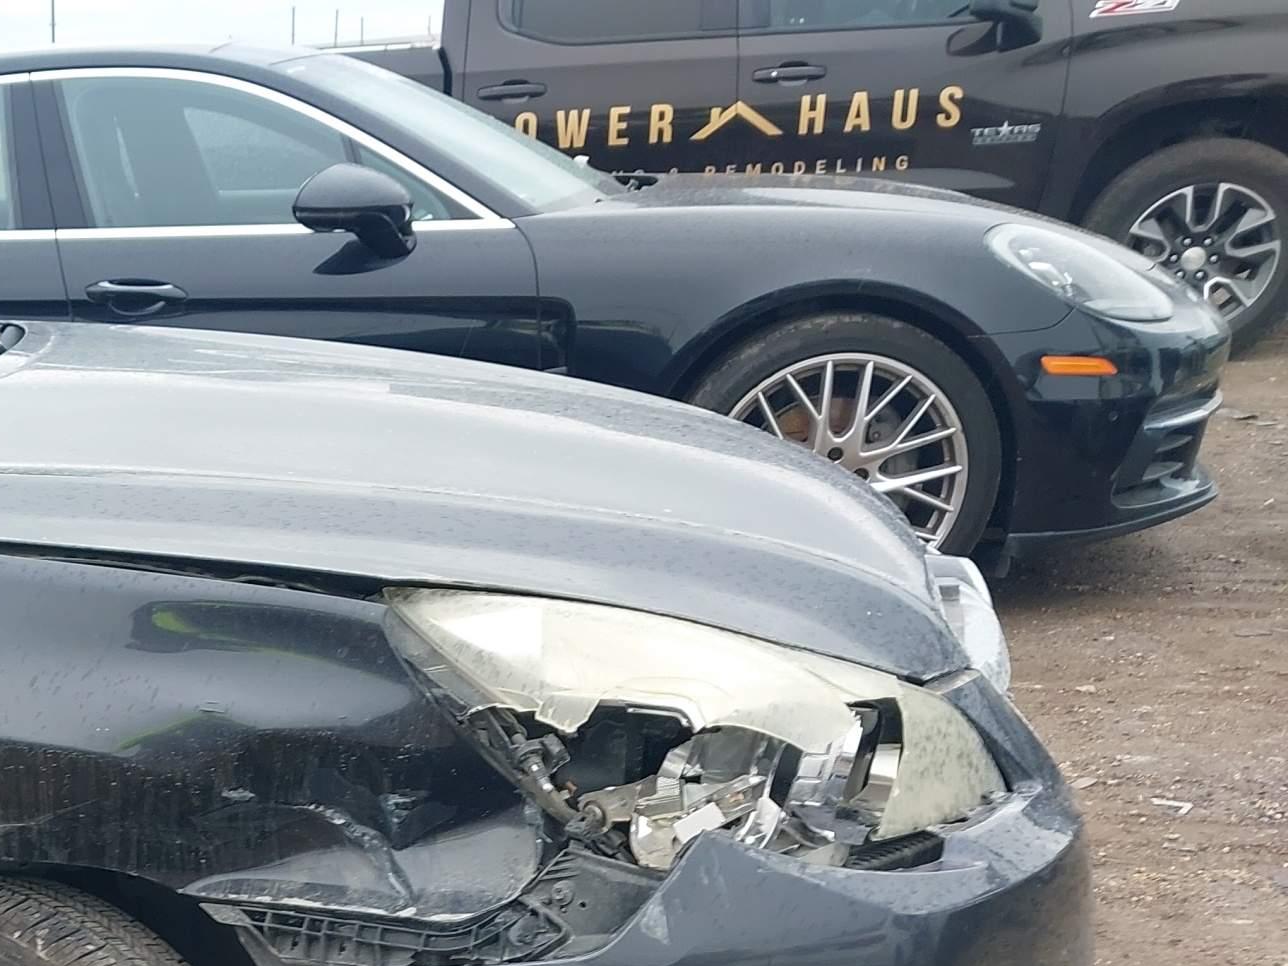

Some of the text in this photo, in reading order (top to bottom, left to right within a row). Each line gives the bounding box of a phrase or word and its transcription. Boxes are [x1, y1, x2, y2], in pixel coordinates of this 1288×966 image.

[514, 85, 965, 149] OWER HAUS
[704, 155, 910, 177] REMODELING
